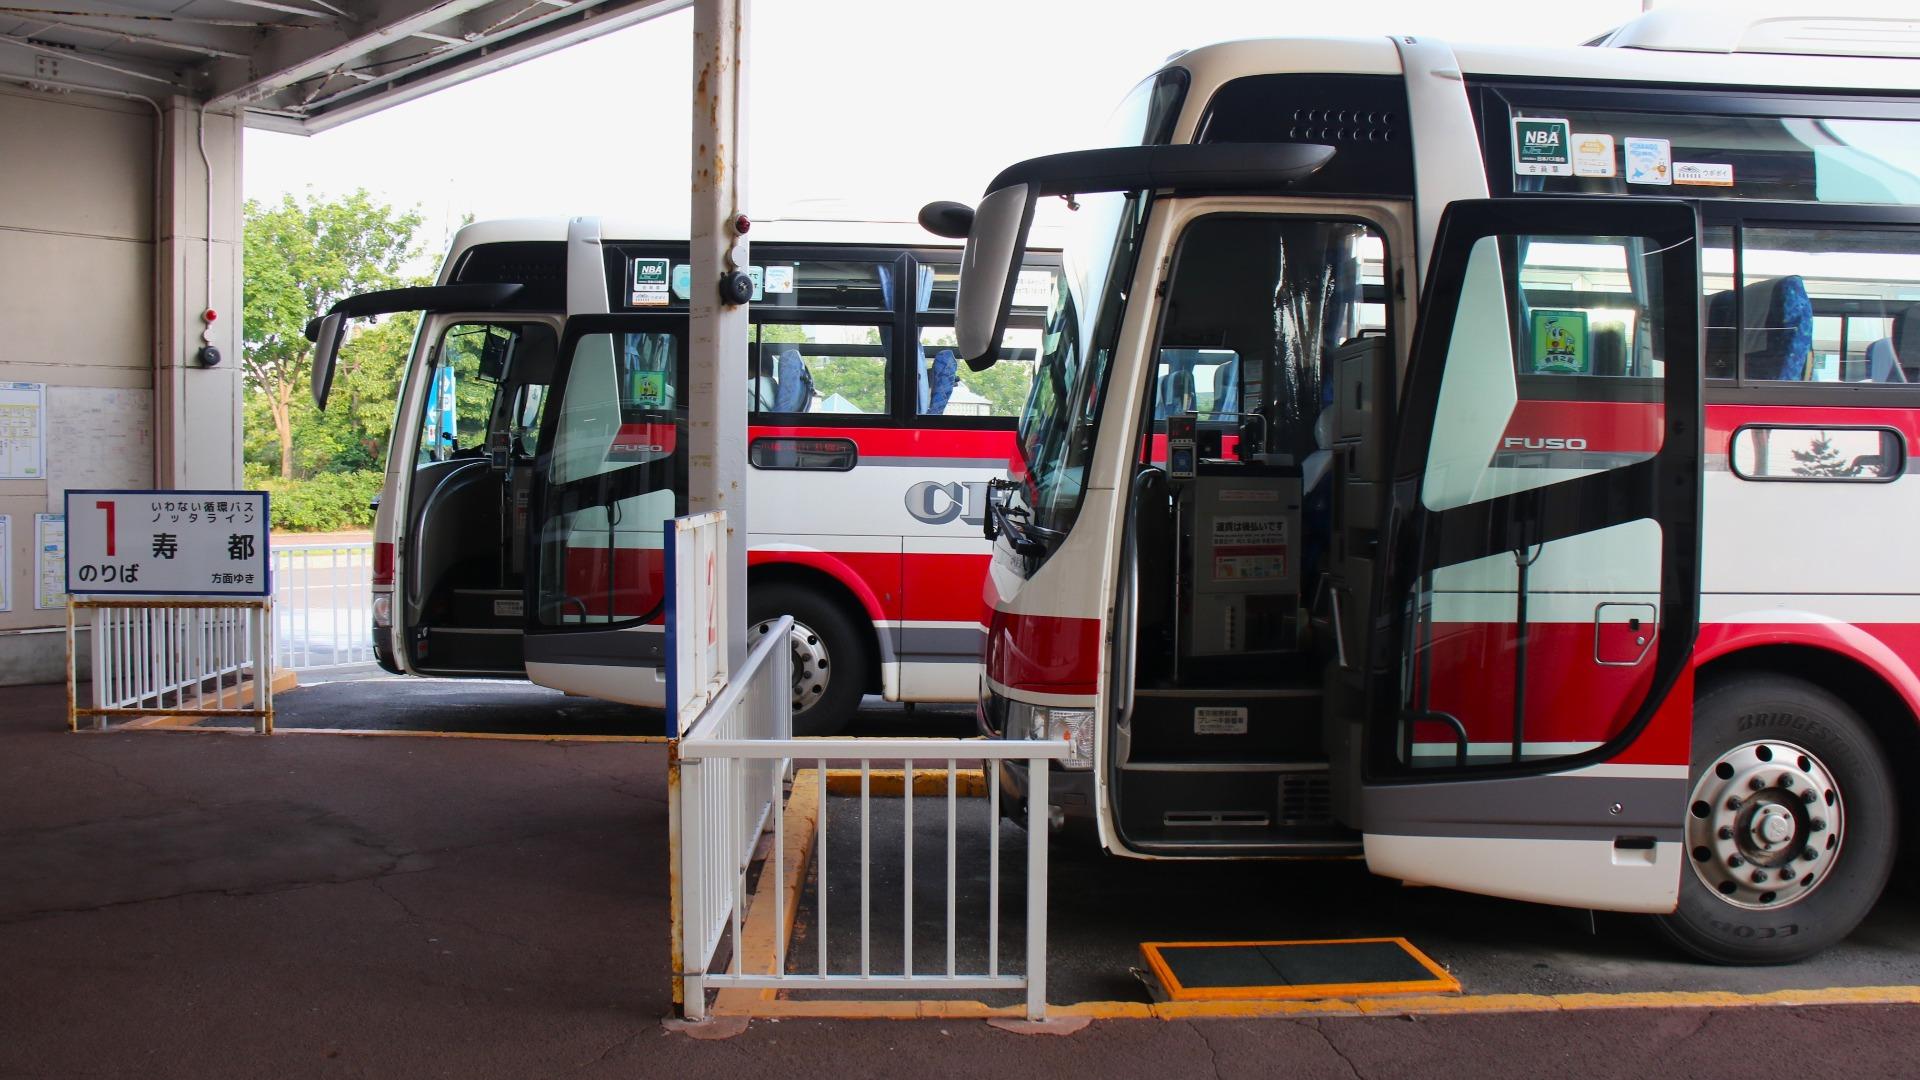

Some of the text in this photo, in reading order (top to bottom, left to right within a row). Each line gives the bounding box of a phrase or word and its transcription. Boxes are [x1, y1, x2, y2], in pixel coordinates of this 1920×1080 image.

[1525, 131, 1560, 144] NBA
[642, 265, 662, 273] NBA
[614, 444, 663, 452] FUSO
[1504, 438, 1587, 450] FUSO
[152, 501, 253, 512] いわない循環バス
[152, 514, 254, 523] ノッタライン
[96, 501, 115, 556] 1
[78, 563, 139, 583] のりば
[211, 573, 255, 584] 方面ゆき
